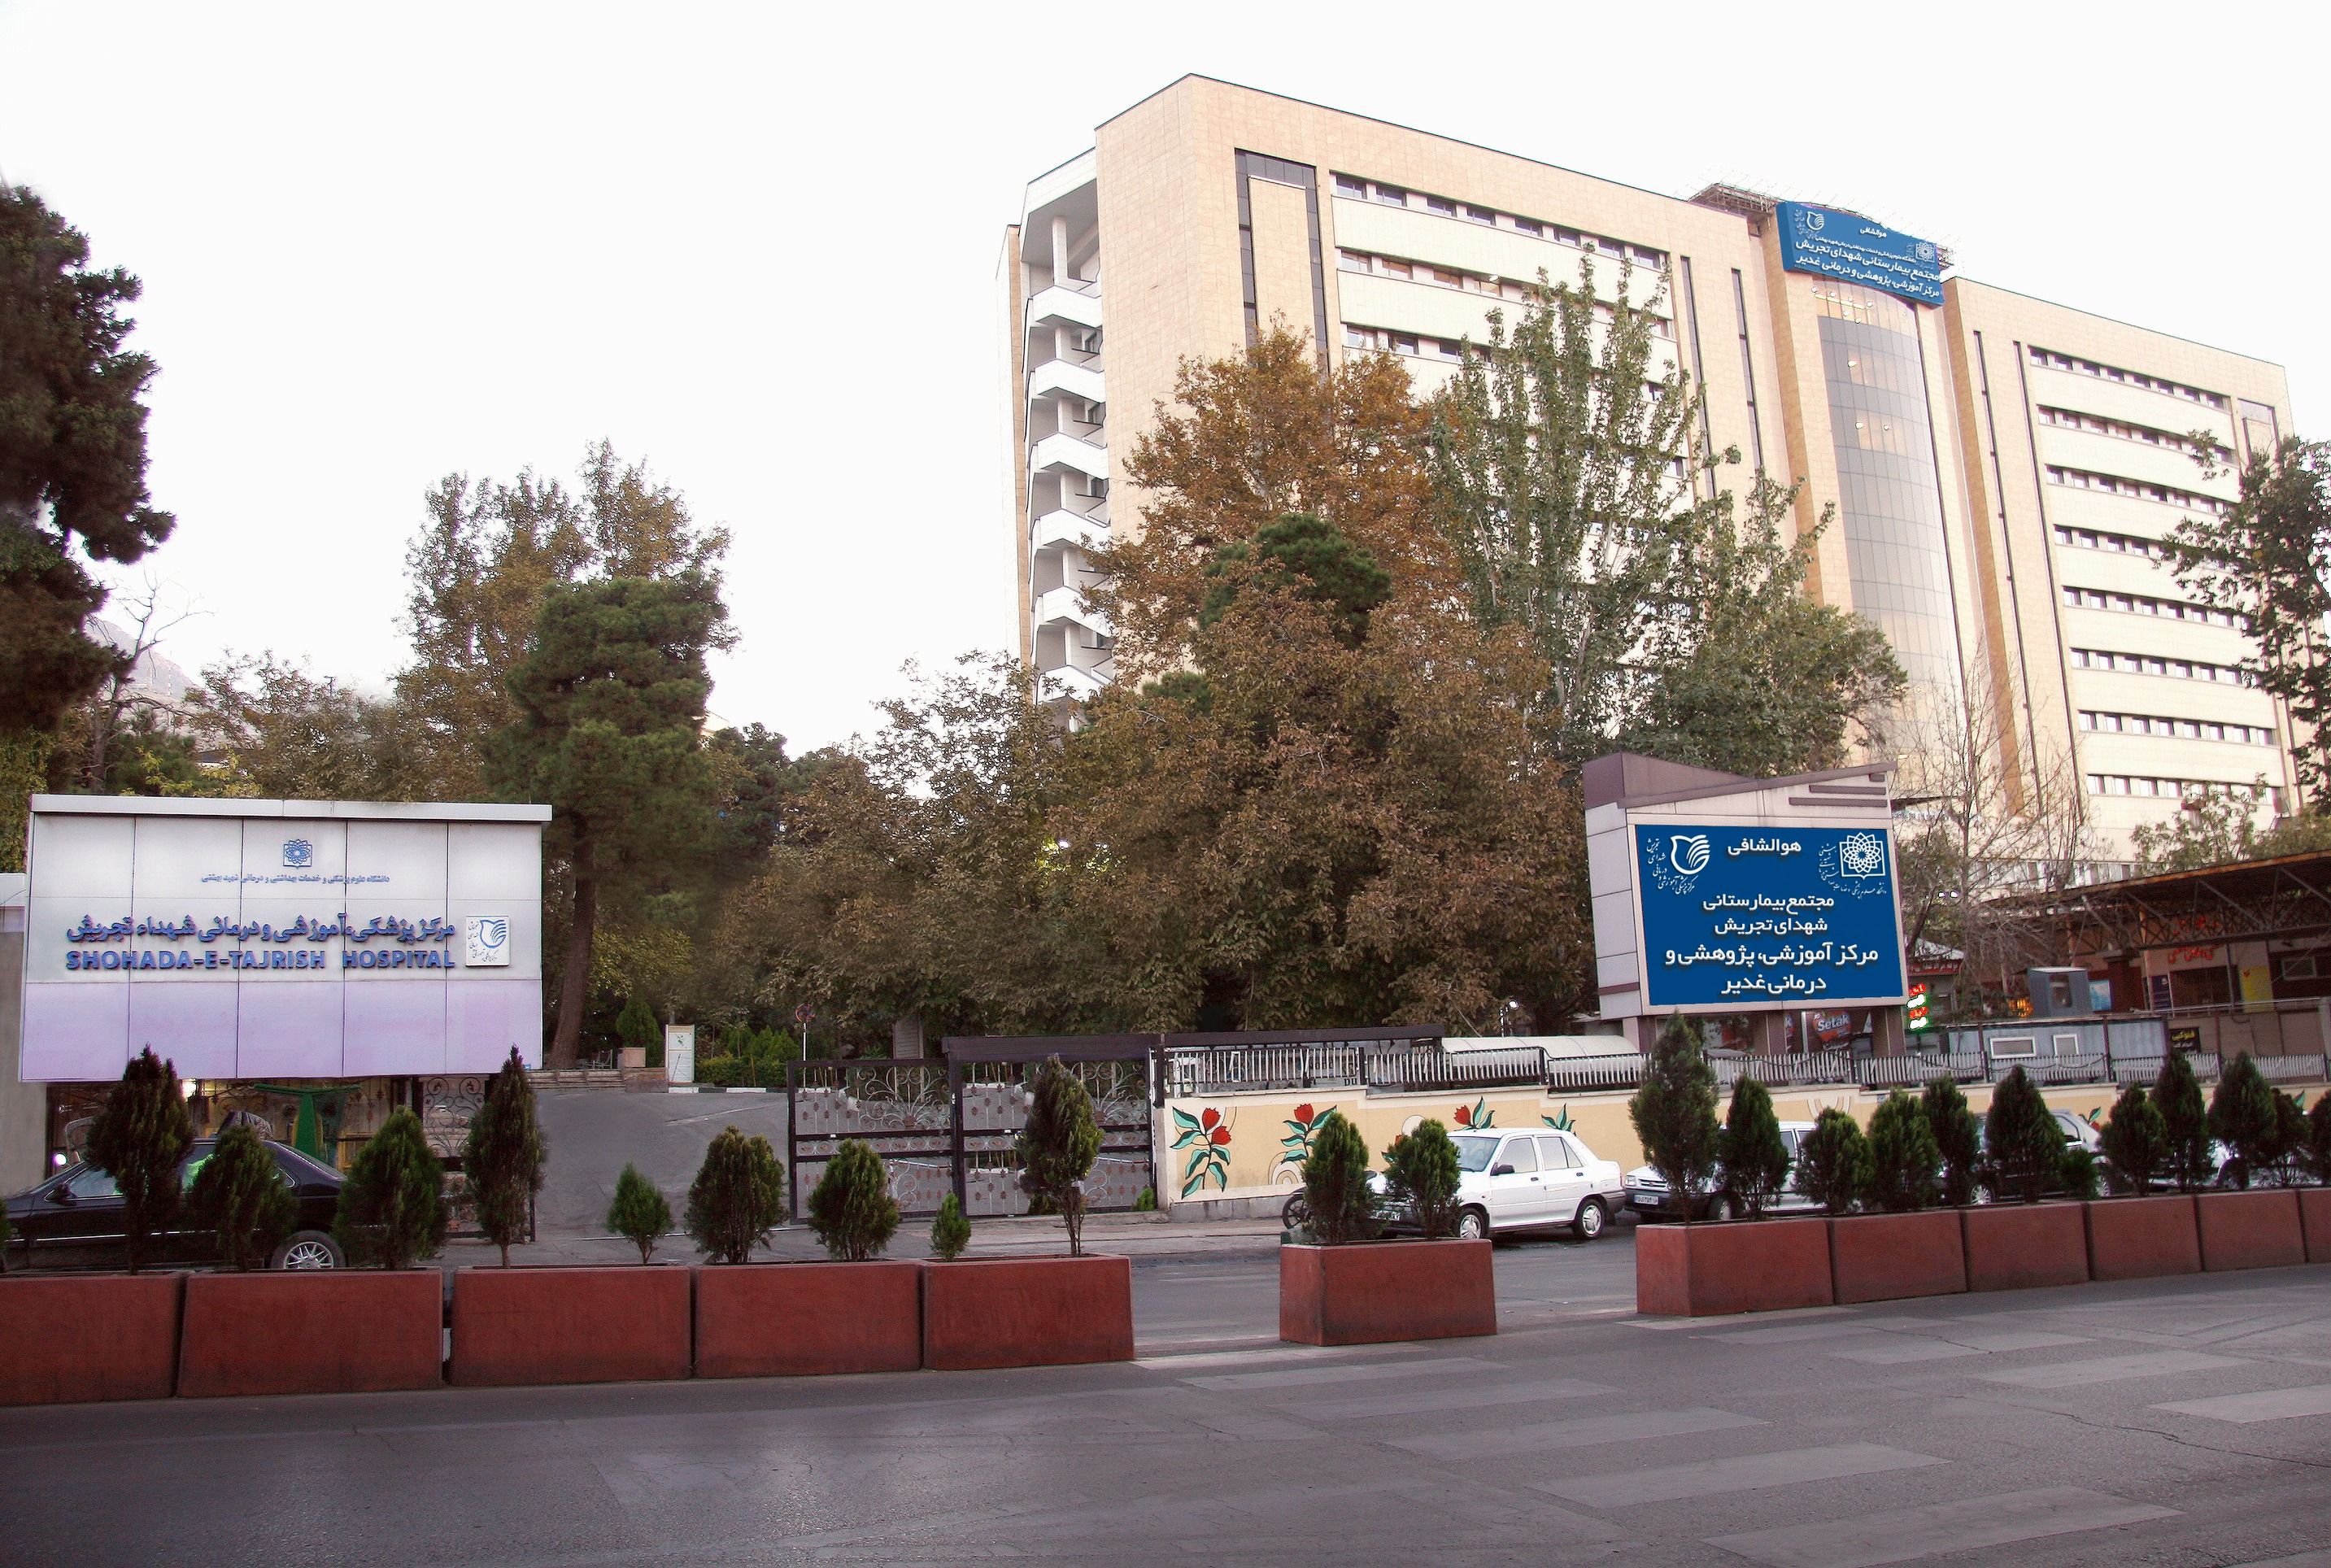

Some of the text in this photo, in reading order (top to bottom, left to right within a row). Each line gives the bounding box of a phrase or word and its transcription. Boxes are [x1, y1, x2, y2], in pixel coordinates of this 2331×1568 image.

[1796, 239, 1830, 255] تجریش
[1830, 247, 1862, 262] شهدای
[1796, 255, 1820, 265] غدیر
[1822, 261, 1851, 274] درمانی
[1862, 256, 1911, 276] بیمارستانی
[1850, 268, 1857, 277] و
[1856, 269, 1892, 287] پژوهشی
[1910, 268, 1939, 281] مجتمع
[1922, 285, 1940, 297] مرکز
[1702, 893, 1835, 915] مجتمع بیمارستانی
[66, 913, 134, 943] تجریش
[136, 914, 198, 942] شهداء
[198, 916, 259, 943] درمانی
[261, 923, 272, 942] و
[416, 917, 455, 942] مرکز
[1714, 917, 1828, 937] شهدای تجریش
[66, 950, 325, 970] SHOHADA-E-TAJRISH
[342, 950, 456, 969] HOSPITAL
[1665, 948, 1676, 966] و
[1677, 943, 1756, 968] پژوهشی
[1835, 943, 1879, 966] مرکز
[1720, 973, 1827, 995] درمانی غدیر
